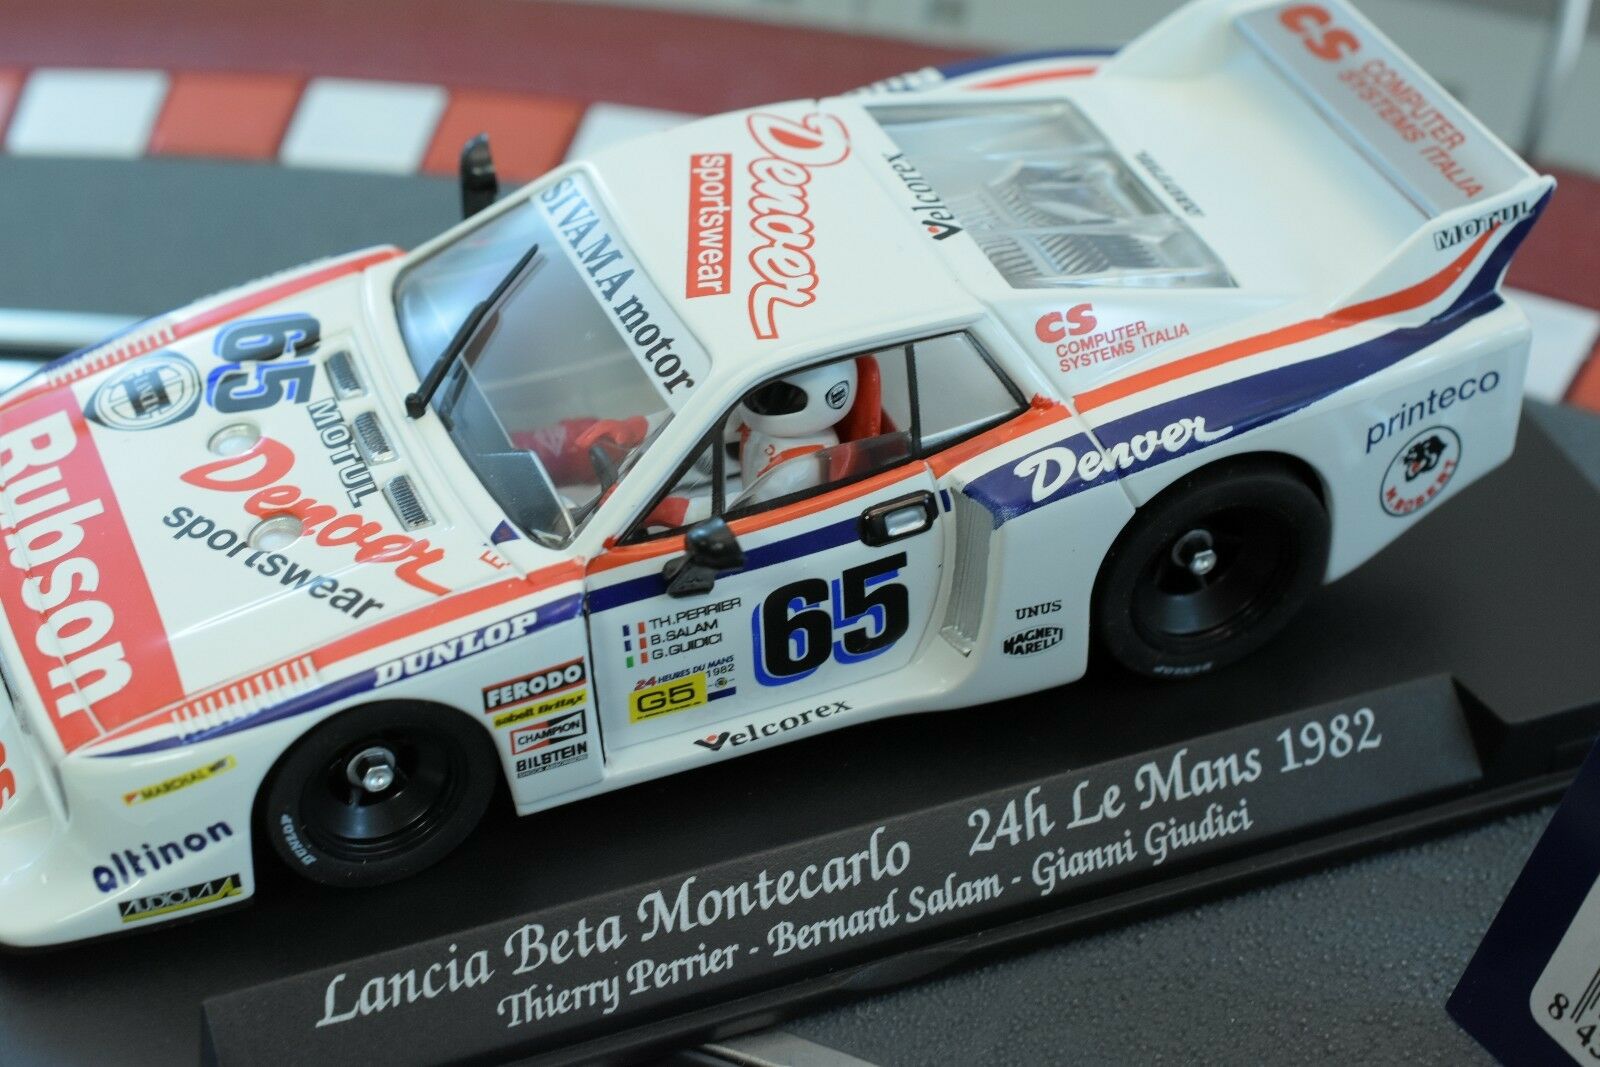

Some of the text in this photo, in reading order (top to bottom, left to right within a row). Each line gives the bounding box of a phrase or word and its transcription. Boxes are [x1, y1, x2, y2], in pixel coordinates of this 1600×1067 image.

[1280, 4, 1361, 62] CS
[1361, 60, 1466, 148] COMPUTER
[882, 153, 963, 241] Velcorex
[1420, 146, 1484, 198] ITALIA
[697, 155, 727, 292] sportswear
[747, 113, 850, 340] Denver
[1434, 201, 1535, 251] MOTUL
[541, 178, 694, 395] SIVAMA motor
[1035, 303, 1097, 343] CS
[1056, 321, 1147, 357] COMPUTER
[1060, 323, 1190, 372] SYSTEMS ITALIA
[207, 313, 320, 413] 65
[1366, 371, 1500, 454] printeco
[305, 398, 381, 507] MOTUL
[1013, 416, 1233, 502] Denver
[180, 436, 452, 596] Denver
[0, 410, 132, 717] Rubson
[163, 506, 385, 620] sportswear
[649, 597, 741, 629] TH.PERRIER
[651, 619, 718, 645] B.SALAM
[752, 552, 909, 687] 65
[1015, 599, 1062, 620] UNUS
[374, 612, 538, 687] DUNLOP
[634, 676, 657, 691] 24
[693, 665, 706, 674] DU
[708, 655, 734, 668] MANS
[707, 664, 734, 678] 1982
[487, 665, 582, 708] FERODO
[637, 682, 695, 713] G5
[516, 741, 588, 772] BILSTEIN
[518, 720, 580, 746] CHAMPION
[694, 698, 853, 751] Velcorex
[93, 821, 234, 893] altinon
[315, 707, 1382, 1028] Lancia Beta Montecarlo 24h Le Mans 1982
[497, 975, 619, 1028] Thierry
[626, 944, 739, 995] Perrier
[768, 889, 899, 956] Bernard
[906, 872, 1004, 923] Salam
[1031, 830, 1137, 896] Gianni
[1144, 799, 1253, 866] Giudici
[1548, 993, 1569, 1020] 8
